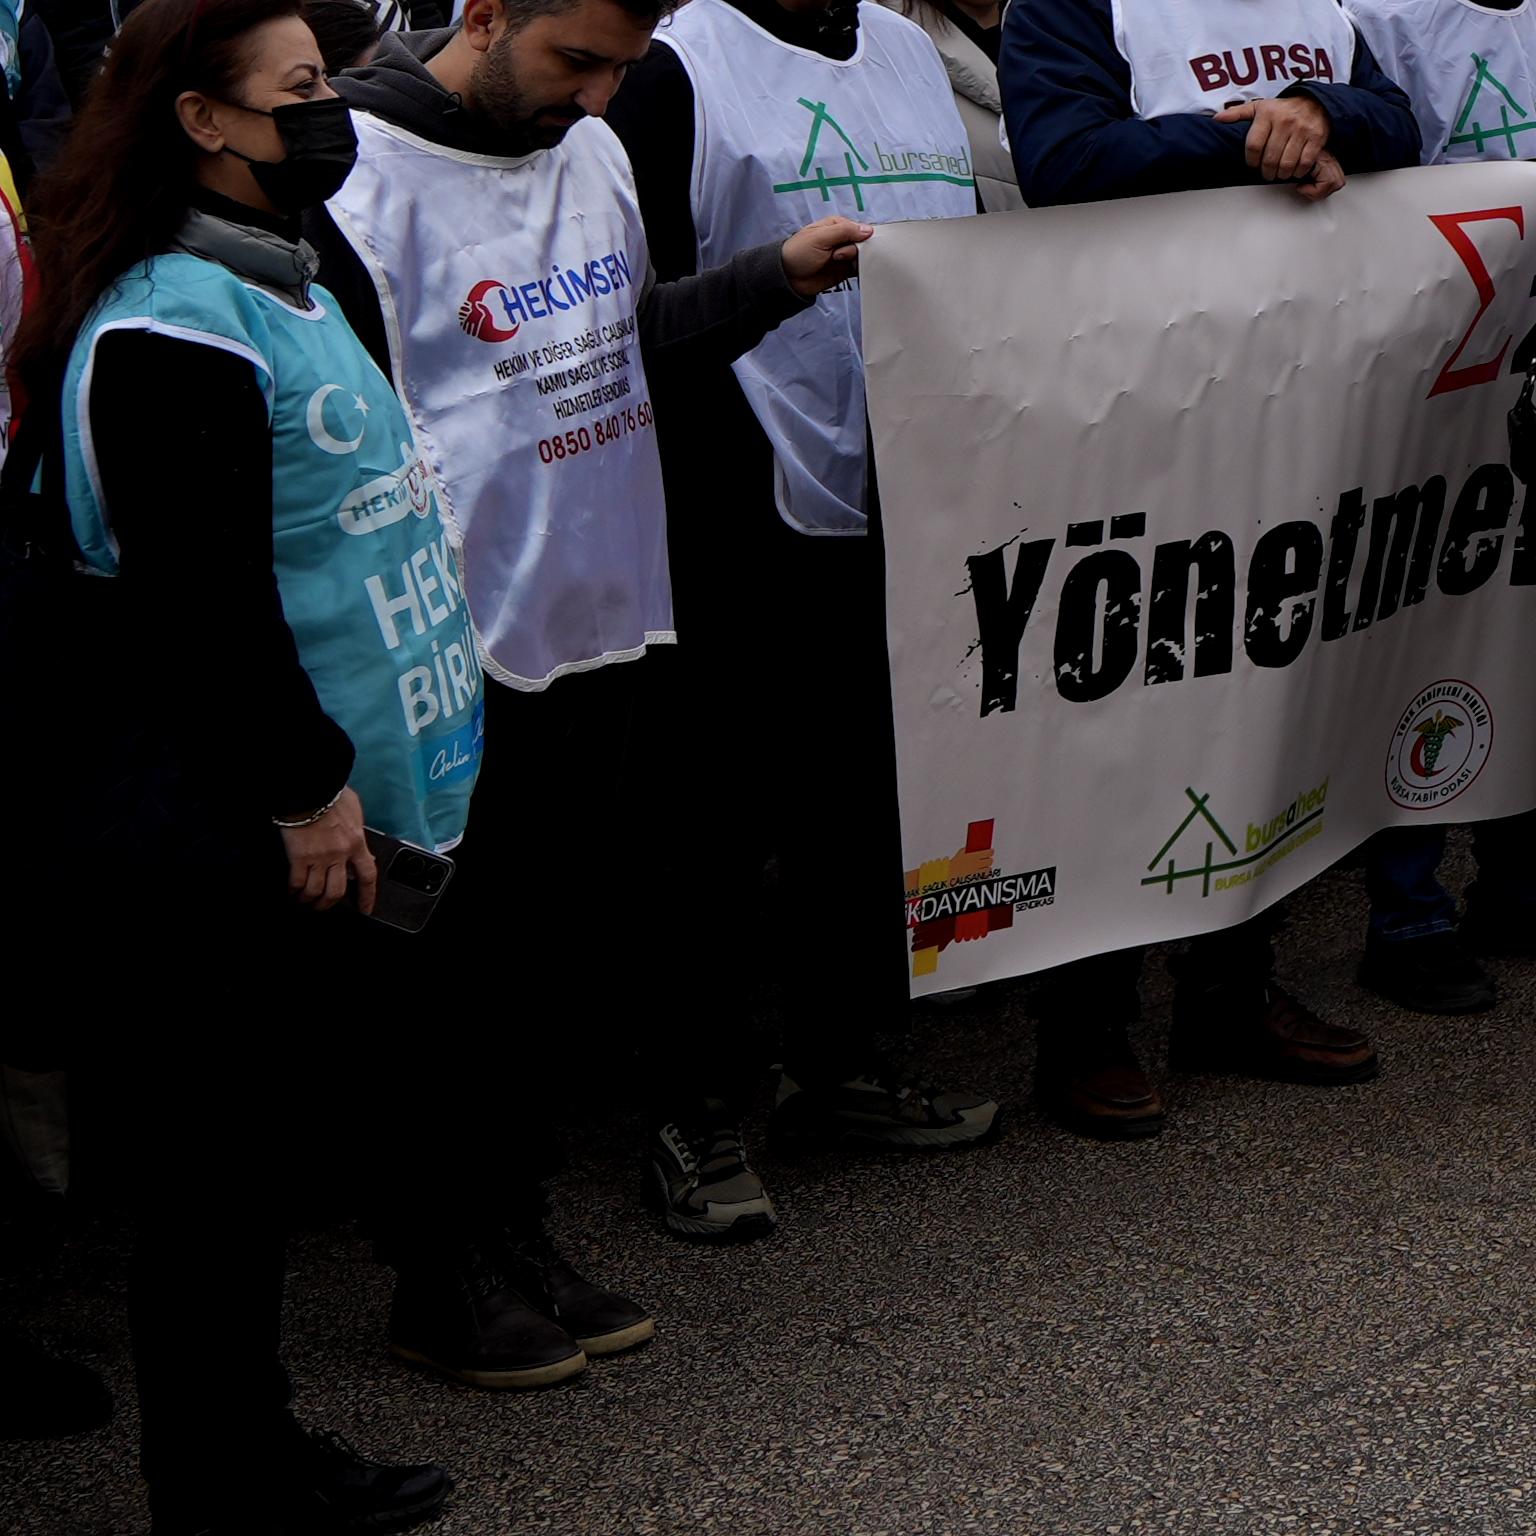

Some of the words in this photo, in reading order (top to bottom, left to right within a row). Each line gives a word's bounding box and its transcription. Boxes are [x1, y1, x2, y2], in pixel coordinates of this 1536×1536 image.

[1189, 43, 1334, 93] BURSA
[499, 250, 632, 325] HEKİMSEN
[538, 427, 591, 464] 0850
[594, 415, 620, 446] 840
[621, 407, 636, 435] 76
[637, 400, 653, 428] 60
